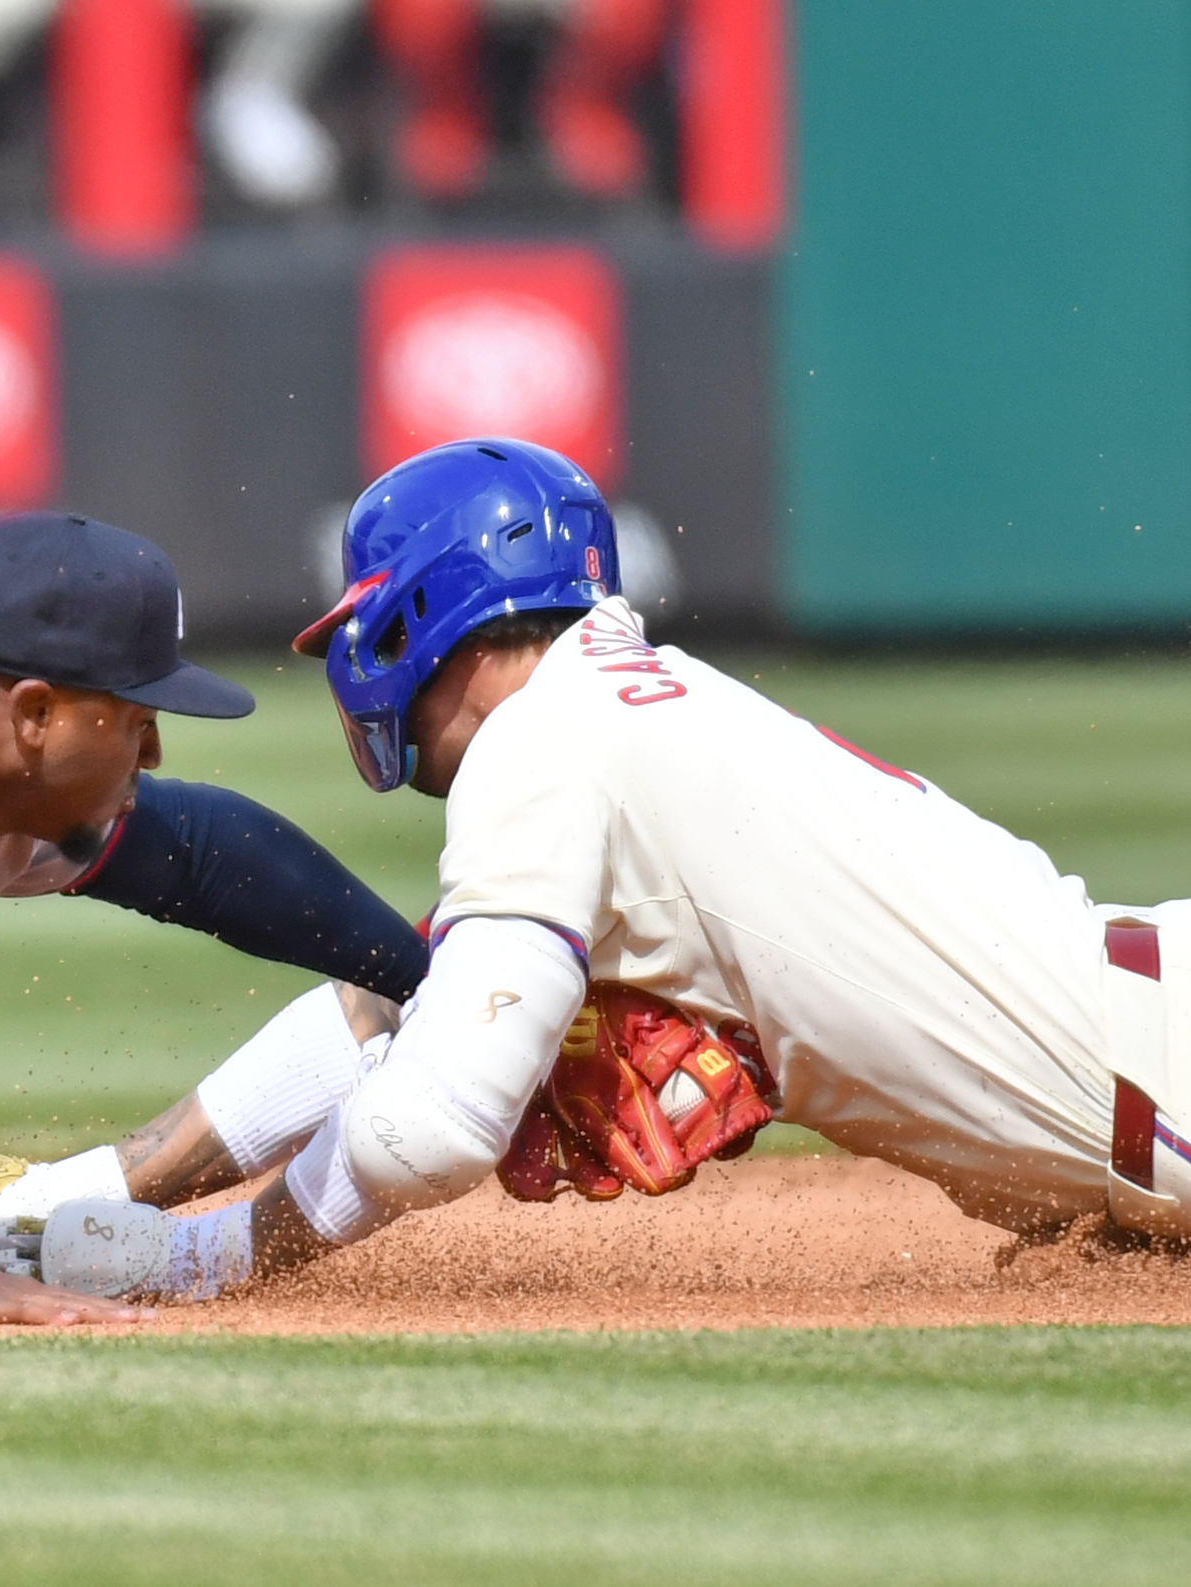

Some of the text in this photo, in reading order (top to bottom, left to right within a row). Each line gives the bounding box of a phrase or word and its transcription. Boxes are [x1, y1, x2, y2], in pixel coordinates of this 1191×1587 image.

[585, 546, 600, 580] 8
[579, 600, 687, 706] CASTE
[83, 1215, 115, 1242] 8
